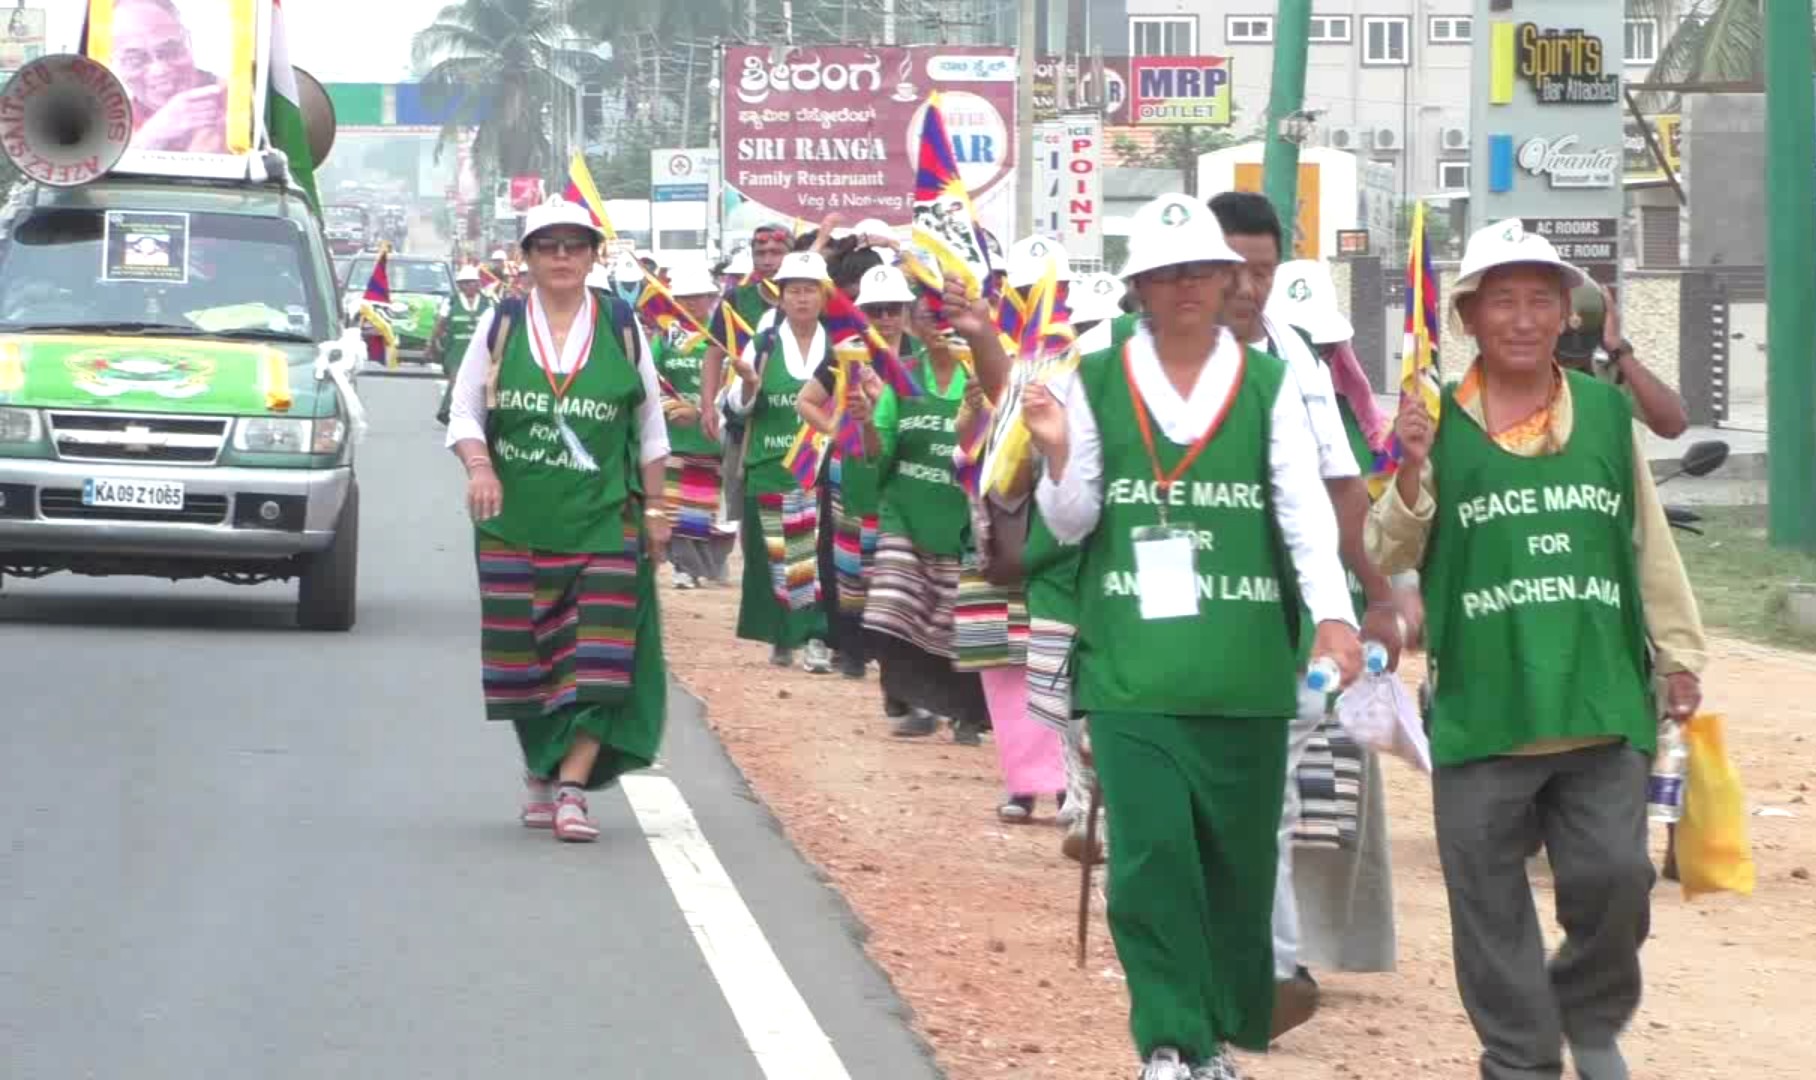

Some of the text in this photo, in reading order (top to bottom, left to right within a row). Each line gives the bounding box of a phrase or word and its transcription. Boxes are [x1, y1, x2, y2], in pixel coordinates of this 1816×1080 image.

[1521, 24, 1602, 90] Spirits
[1139, 68, 1228, 98] MRP
[1141, 104, 1215, 118] OUTLET
[1068, 127, 1092, 136] ICE
[738, 137, 888, 161] SRI RANGA
[739, 170, 792, 189] Family
[1069, 139, 1093, 235] POINT
[797, 192, 825, 208] Veg
[829, 193, 840, 207] &
[843, 192, 902, 209] Non-veg
[1536, 221, 1600, 235] AC ROOMS
[1574, 244, 1611, 258] ROOM
[1192, 482, 1265, 510] MARC
[1458, 484, 1621, 528] PEACE MARCH
[1527, 533, 1572, 556] FOR
[1463, 574, 1576, 620] PANCHEN
